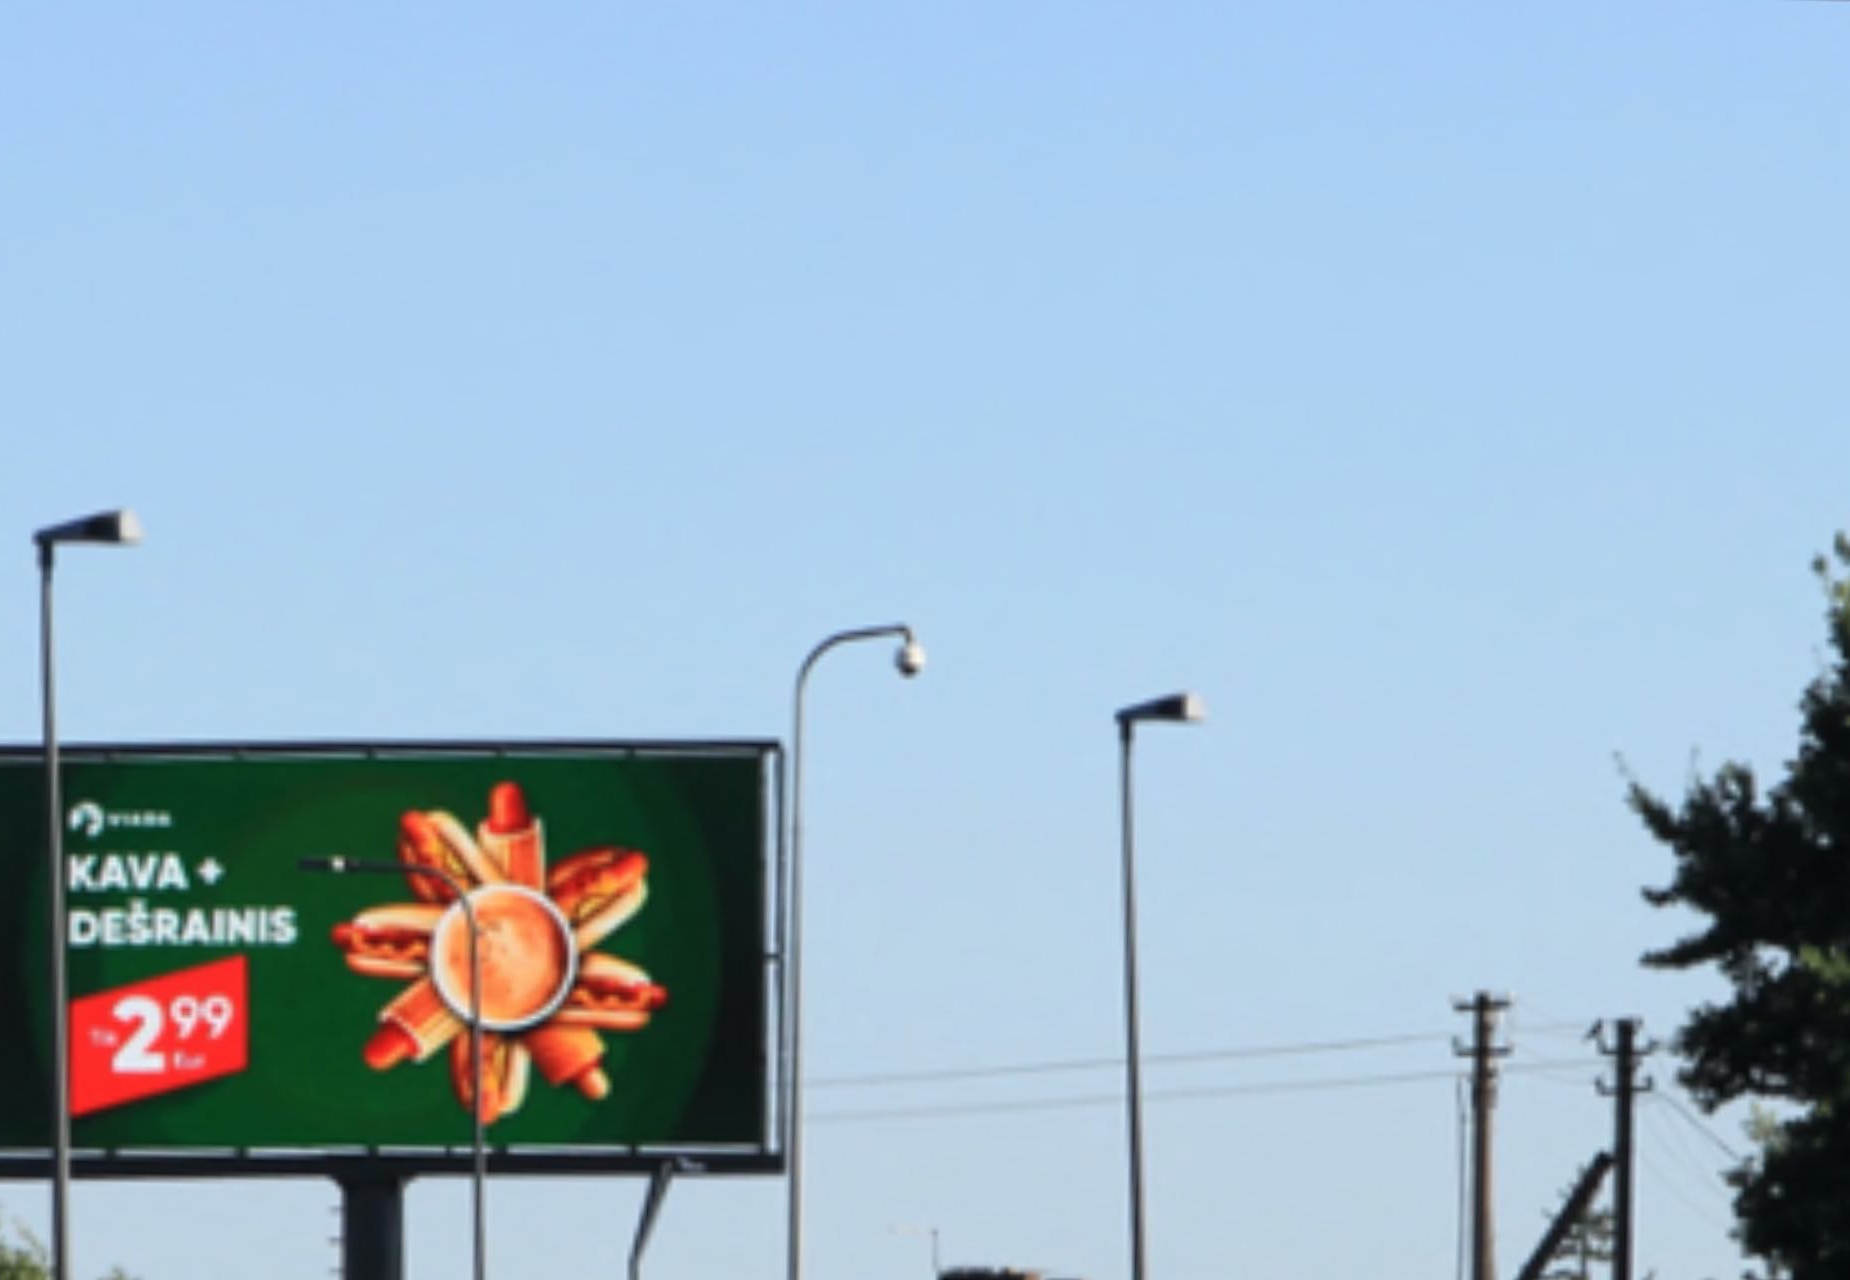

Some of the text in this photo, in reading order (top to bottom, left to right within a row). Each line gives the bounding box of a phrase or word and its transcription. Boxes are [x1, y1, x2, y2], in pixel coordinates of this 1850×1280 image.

[69, 852, 189, 890] KAVA
[69, 898, 298, 944] DEŠRAINIS
[111, 995, 167, 1073] 2
[170, 995, 234, 1040] 99
